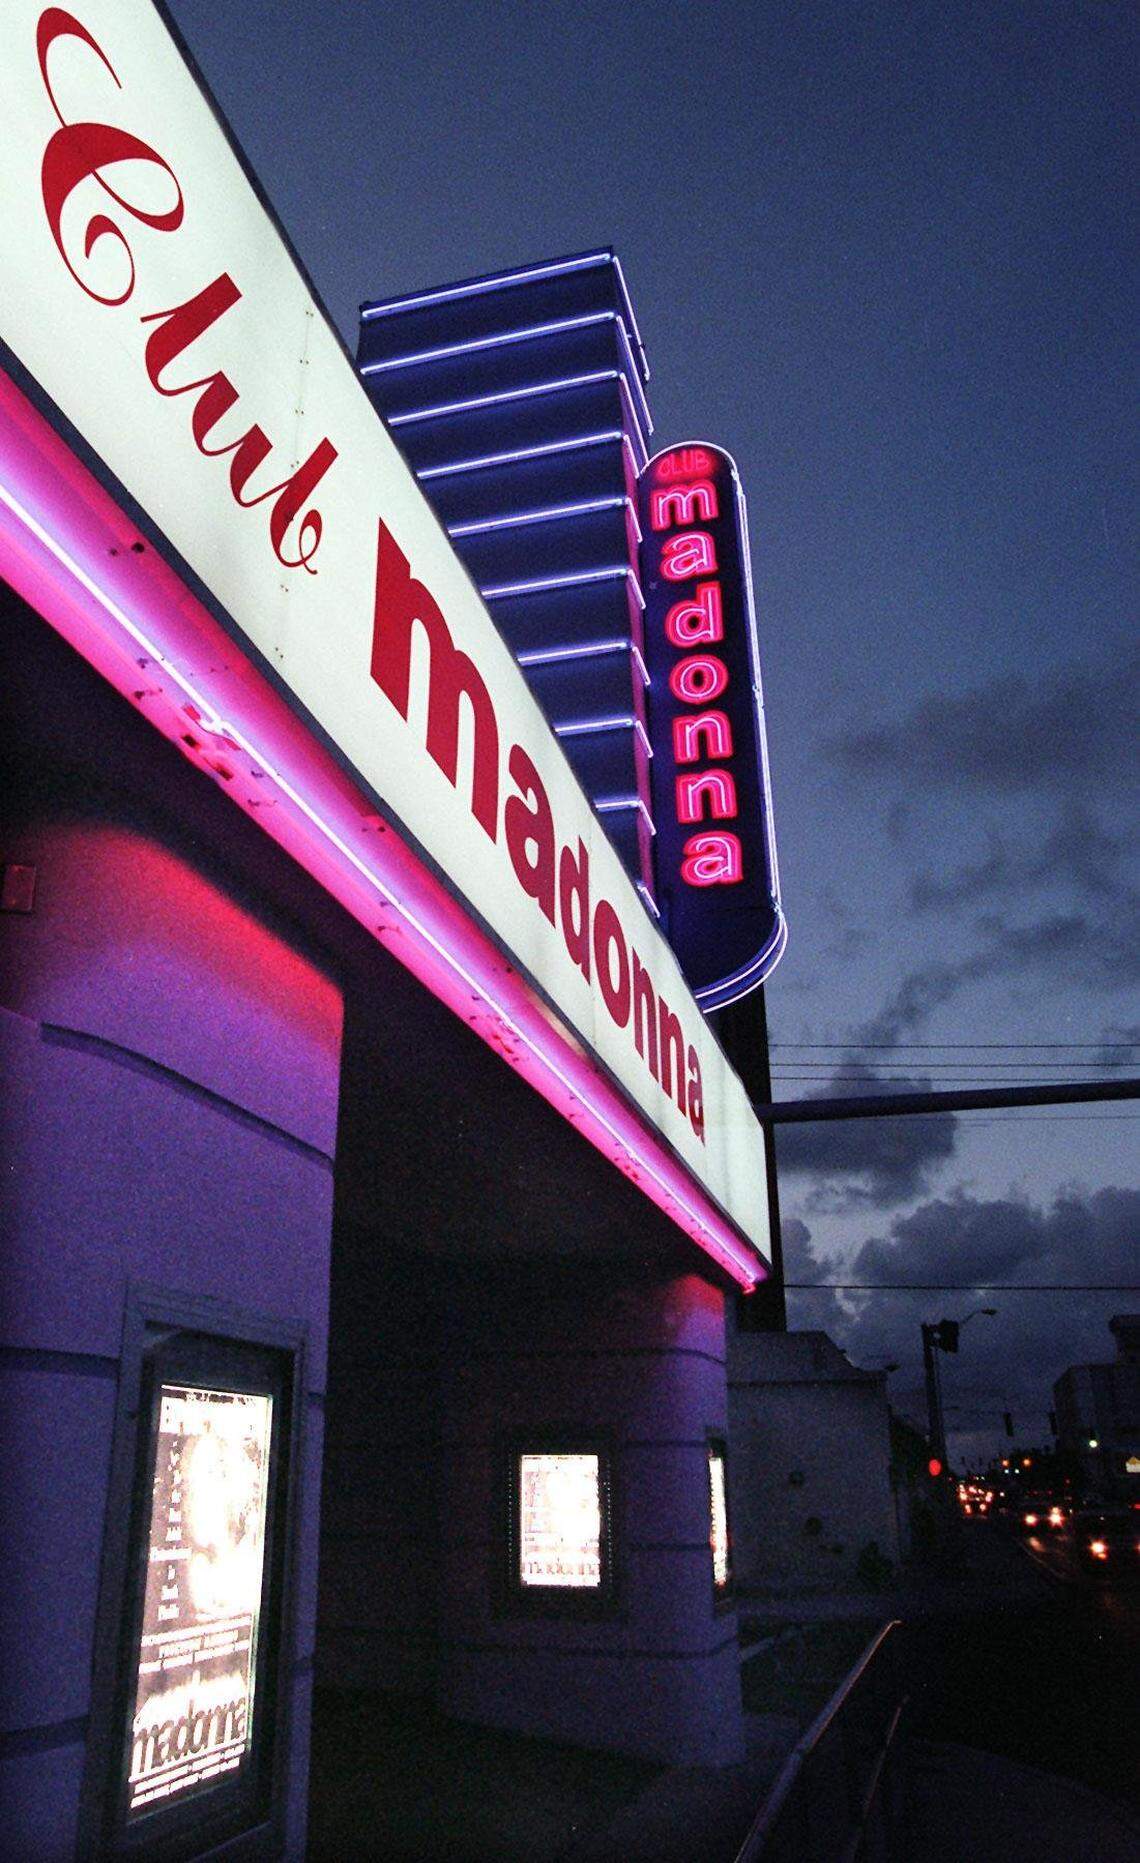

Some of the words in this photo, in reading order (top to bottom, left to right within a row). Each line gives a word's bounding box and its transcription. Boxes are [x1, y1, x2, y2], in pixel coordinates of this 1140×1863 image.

[36, 7, 338, 575] Club
[370, 516, 705, 1146] madonna
[657, 449, 711, 477] CLUB
[650, 479, 744, 888] madonna
